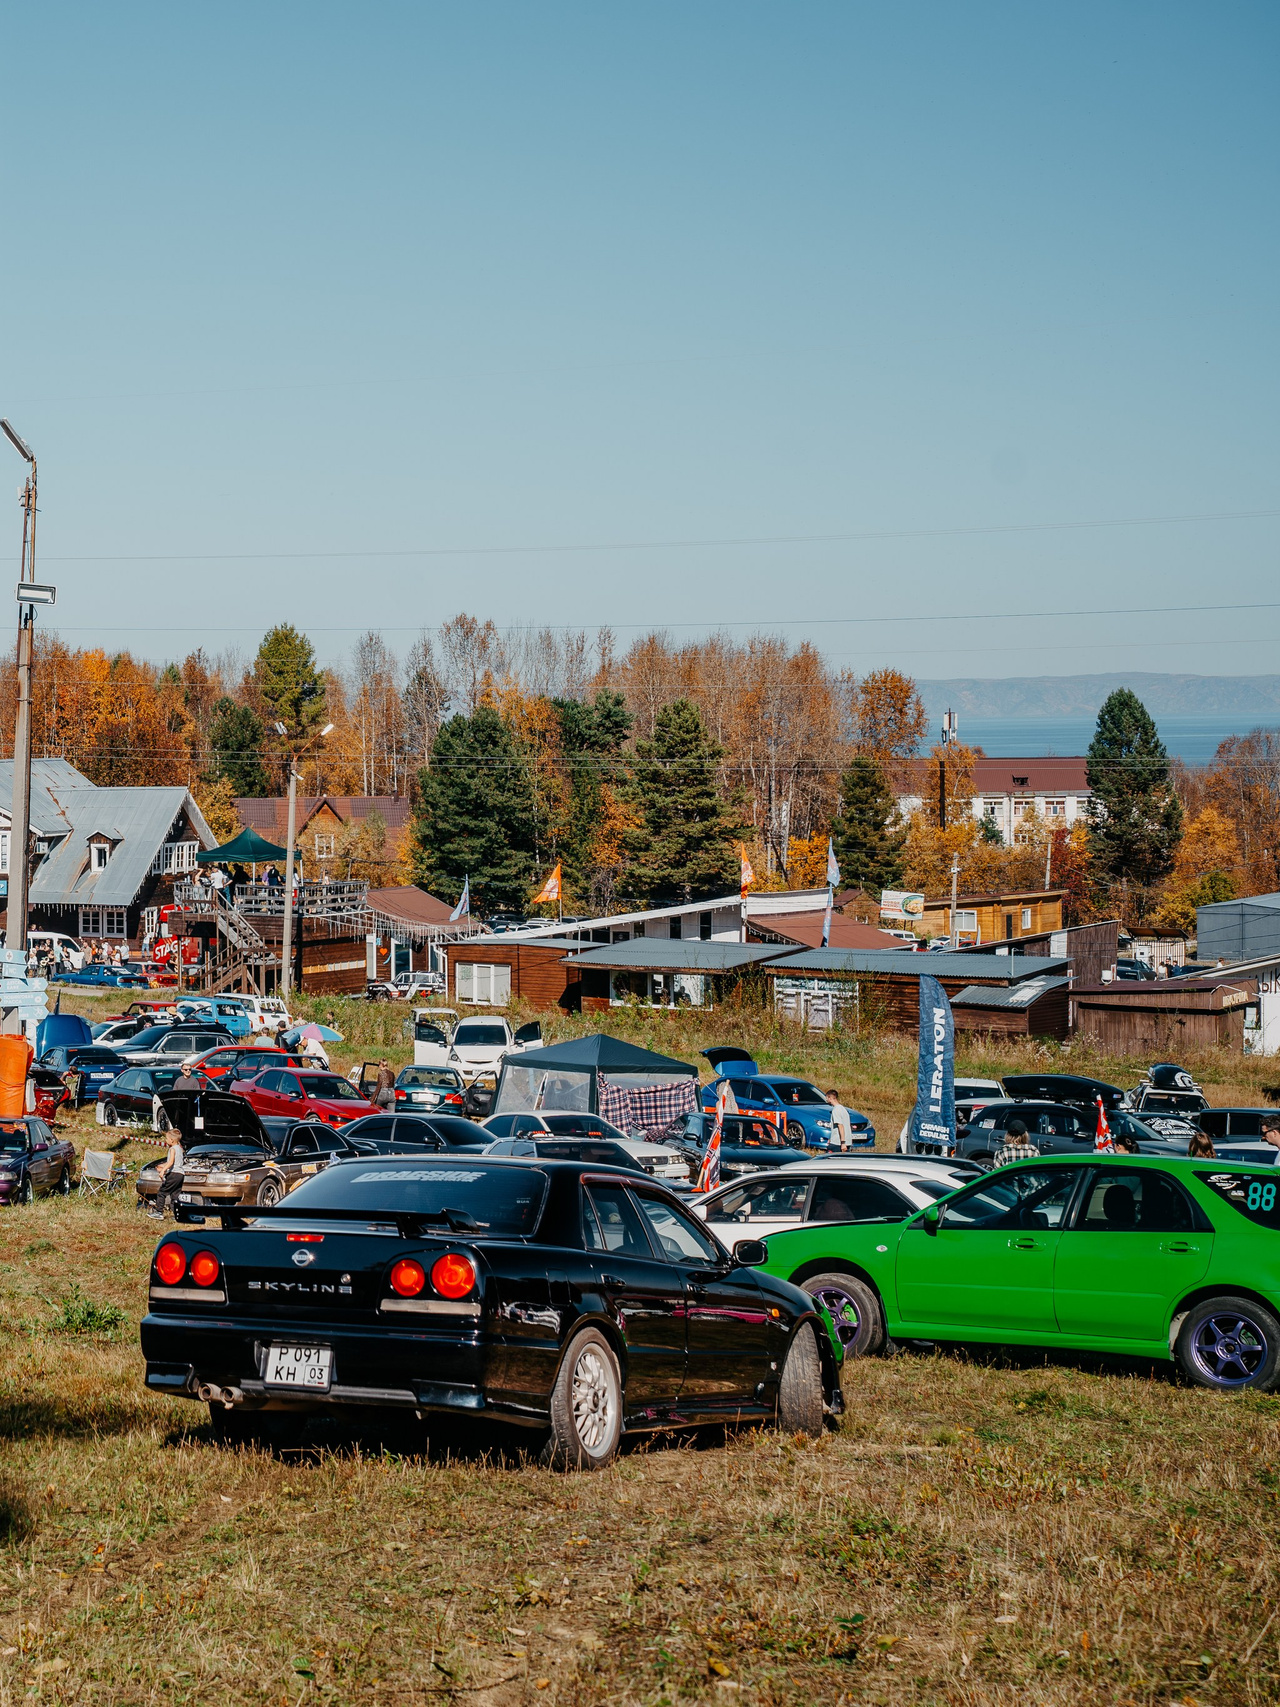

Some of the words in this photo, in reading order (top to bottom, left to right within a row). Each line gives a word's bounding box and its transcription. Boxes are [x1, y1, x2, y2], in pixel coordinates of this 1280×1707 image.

[155, 938, 191, 960] STAG+
[929, 1007, 946, 1113] LERATON
[921, 1122, 950, 1133] CARWASH
[919, 1130, 950, 1141] DETAILING
[350, 1171, 487, 1184] DRAGSIDE
[1247, 1182, 1277, 1211] 88
[248, 1281, 353, 1295] SKYLINE
[279, 1346, 289, 1361] Р
[294, 1347, 321, 1364] 091
[274, 1366, 297, 1381] КН
[309, 1367, 324, 1380] 03
